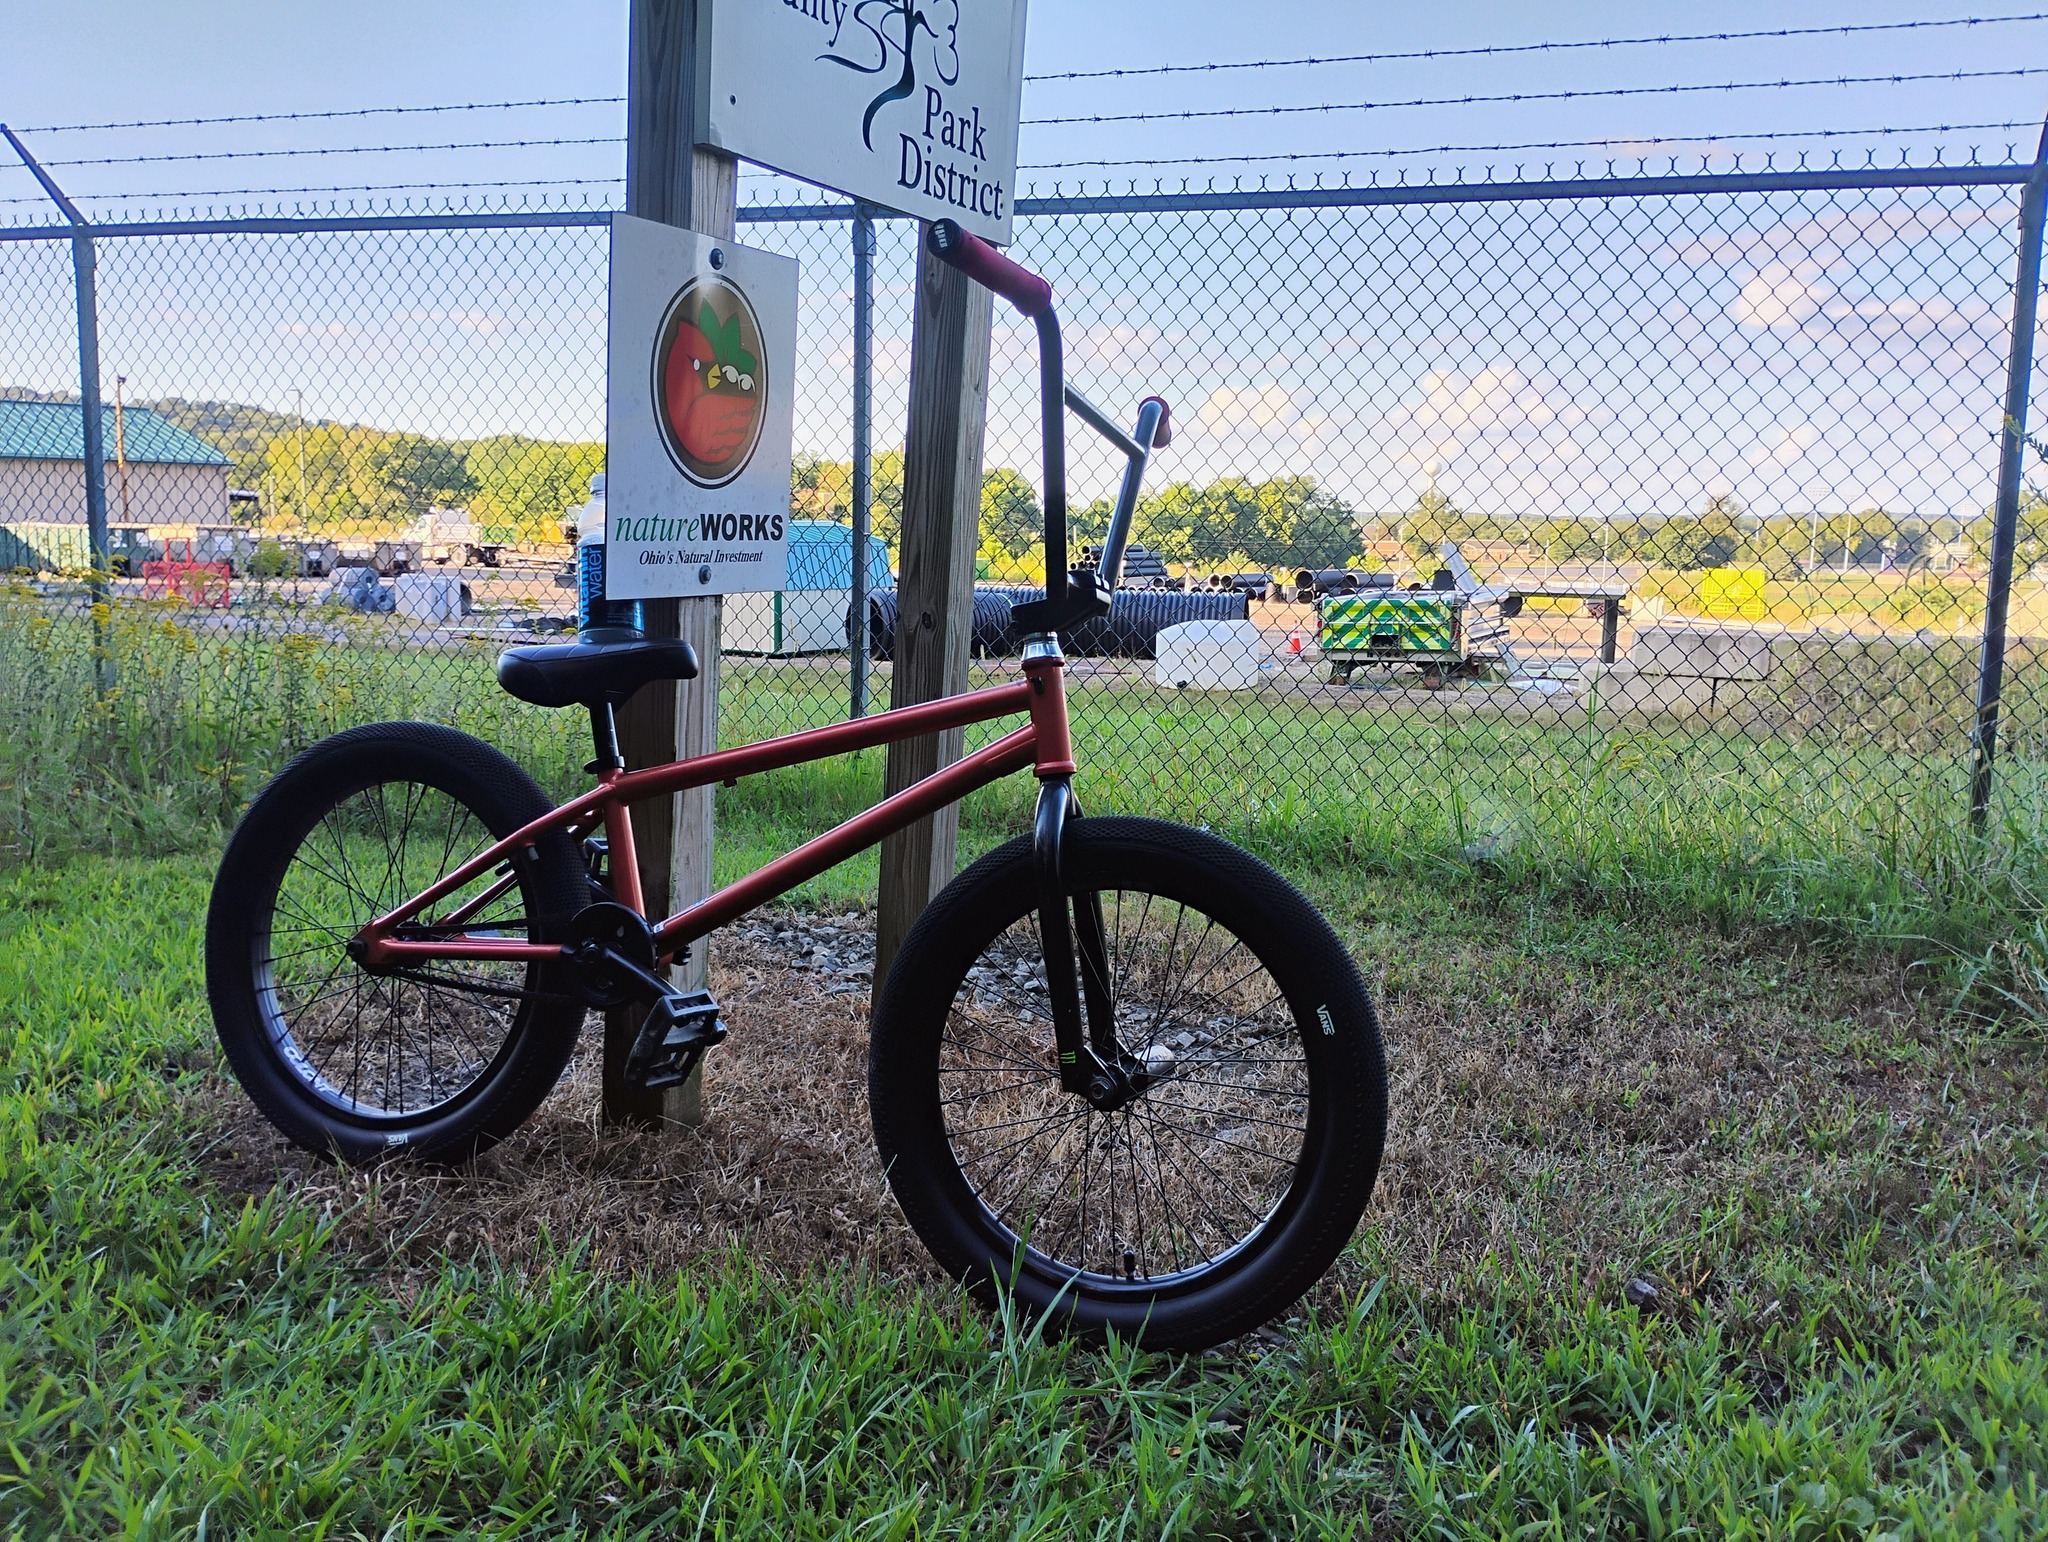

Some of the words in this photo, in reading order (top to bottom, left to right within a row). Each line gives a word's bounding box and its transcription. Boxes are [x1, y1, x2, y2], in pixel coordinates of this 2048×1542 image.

[922, 84, 987, 162] Park
[897, 132, 1003, 220] District
[615, 512, 784, 542] natureWORKS
[588, 547, 603, 599] water
[639, 549, 674, 565] Ohio's
[675, 549, 714, 564] Natural
[714, 549, 764, 563] Investment
[1316, 1003, 1336, 1036] VANS
